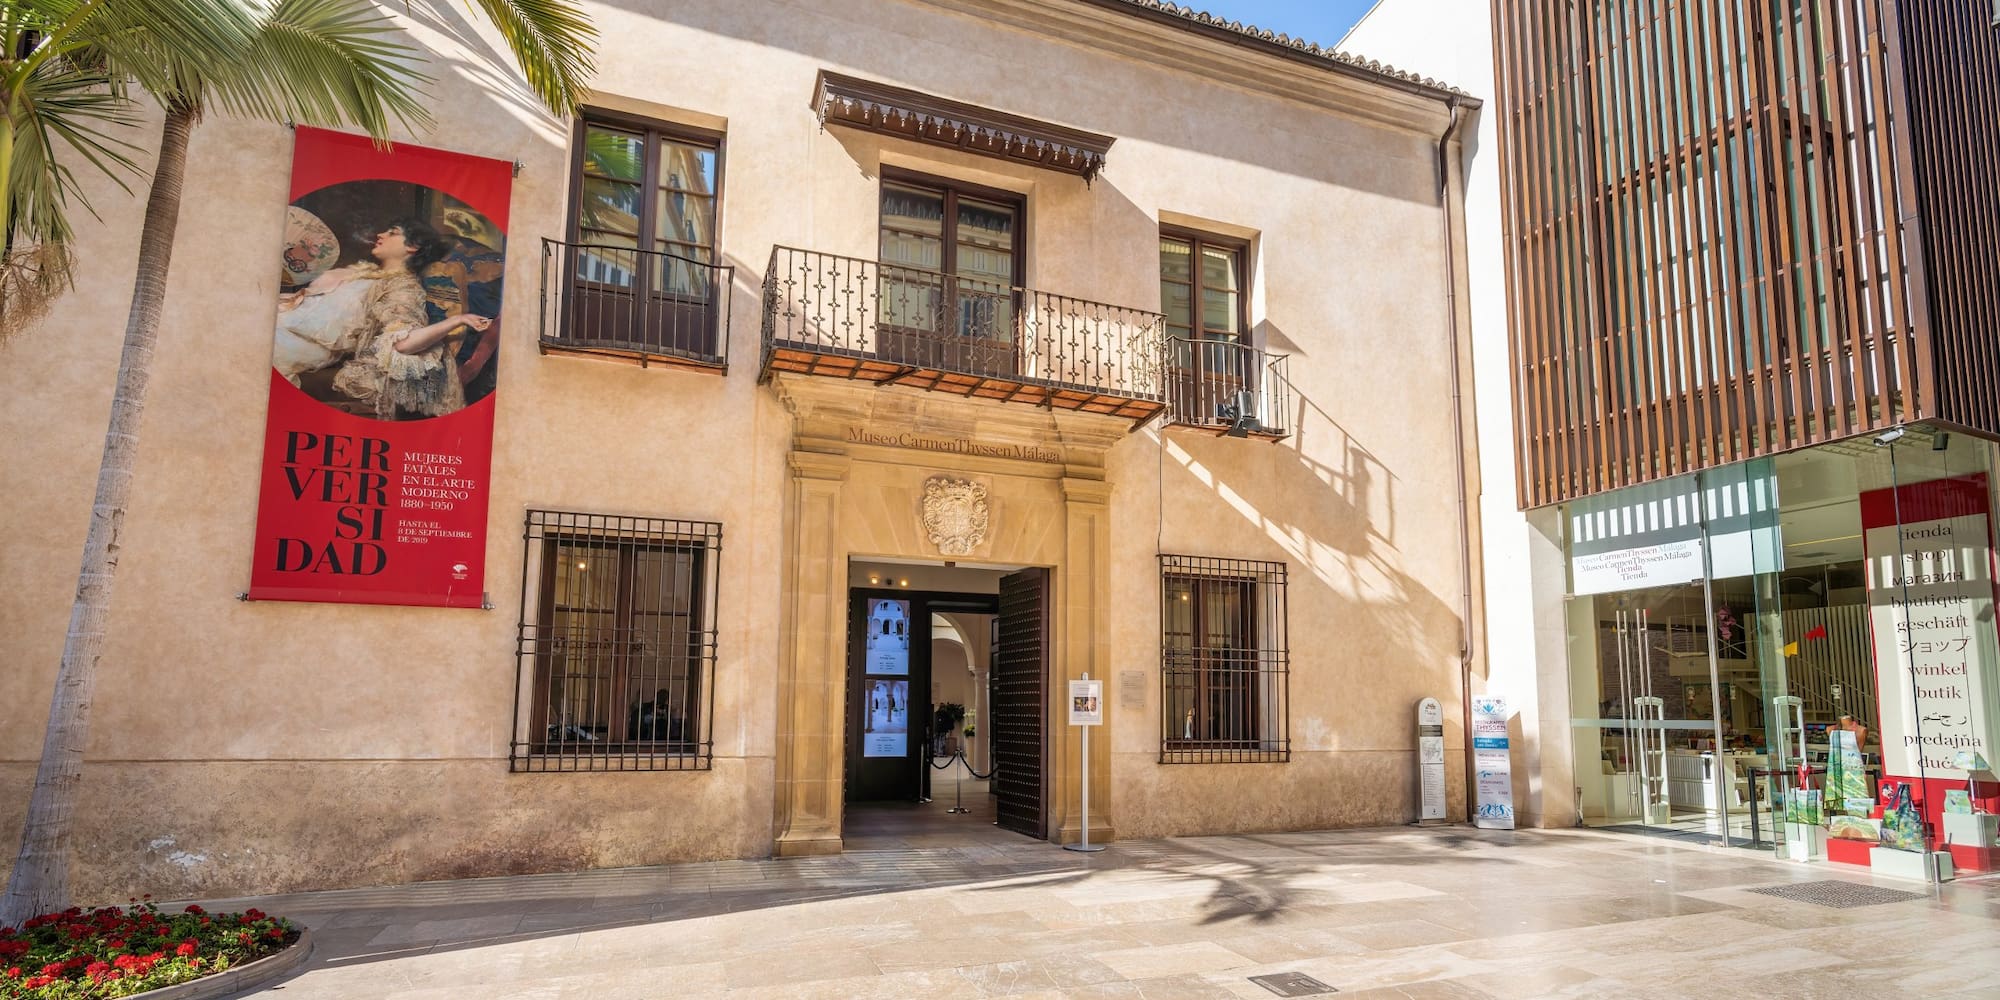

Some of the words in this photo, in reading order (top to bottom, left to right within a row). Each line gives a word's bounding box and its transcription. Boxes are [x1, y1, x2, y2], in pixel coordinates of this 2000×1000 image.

[281, 430, 392, 472] PER
[848, 427, 898, 445] Museo
[899, 432, 956, 451] Carmen
[955, 438, 1011, 458] Thyssen
[1014, 445, 1060, 464] Málaga
[404, 452, 462, 465] MUJERES
[403, 463, 457, 476] FATALES
[281, 466, 390, 506] VER
[402, 475, 420, 485] EN
[423, 476, 439, 487] EL
[441, 478, 475, 489] ARTE
[401, 487, 469, 500] MODERNO
[335, 505, 387, 541] SI
[399, 519, 428, 529] HASTA
[418, 529, 473, 539] SEPTIEMBRE
[272, 537, 387, 576] DAD
[1906, 549, 1947, 562] shop
[1892, 571, 1963, 587] магазин
[1891, 593, 1969, 609] boutique
[1897, 613, 1969, 633] geschäft
[1900, 636, 1973, 653] ショップ
[1908, 662, 1967, 676] winkel
[1917, 686, 1962, 699] butik
[1904, 732, 1981, 749] predajňa
